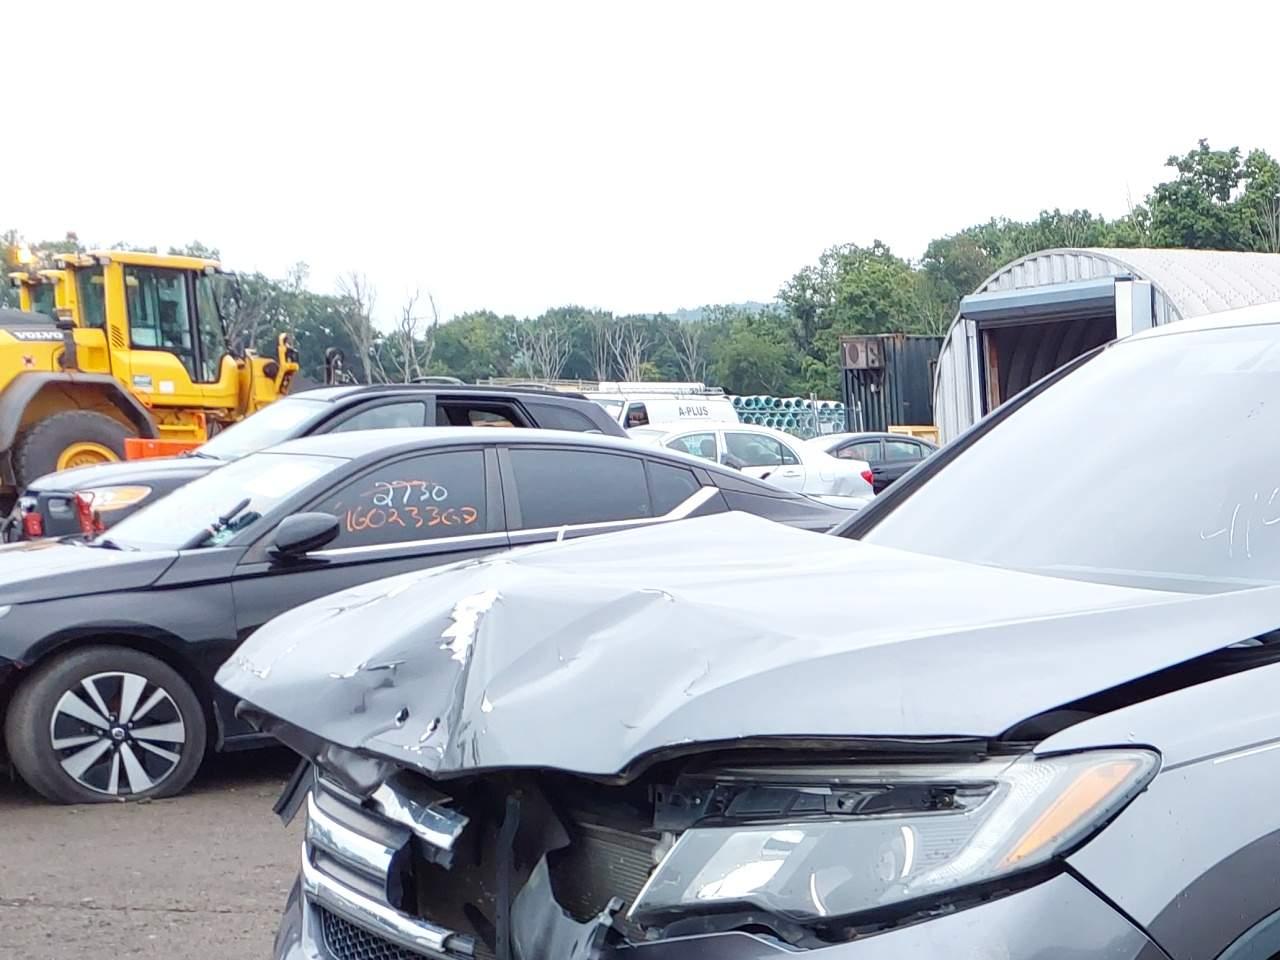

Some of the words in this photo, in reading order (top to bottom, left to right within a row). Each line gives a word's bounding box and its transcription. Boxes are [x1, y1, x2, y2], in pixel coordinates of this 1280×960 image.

[14, 331, 64, 340] VOLVO
[678, 405, 709, 417] A-PLUS
[373, 481, 448, 507] 2730
